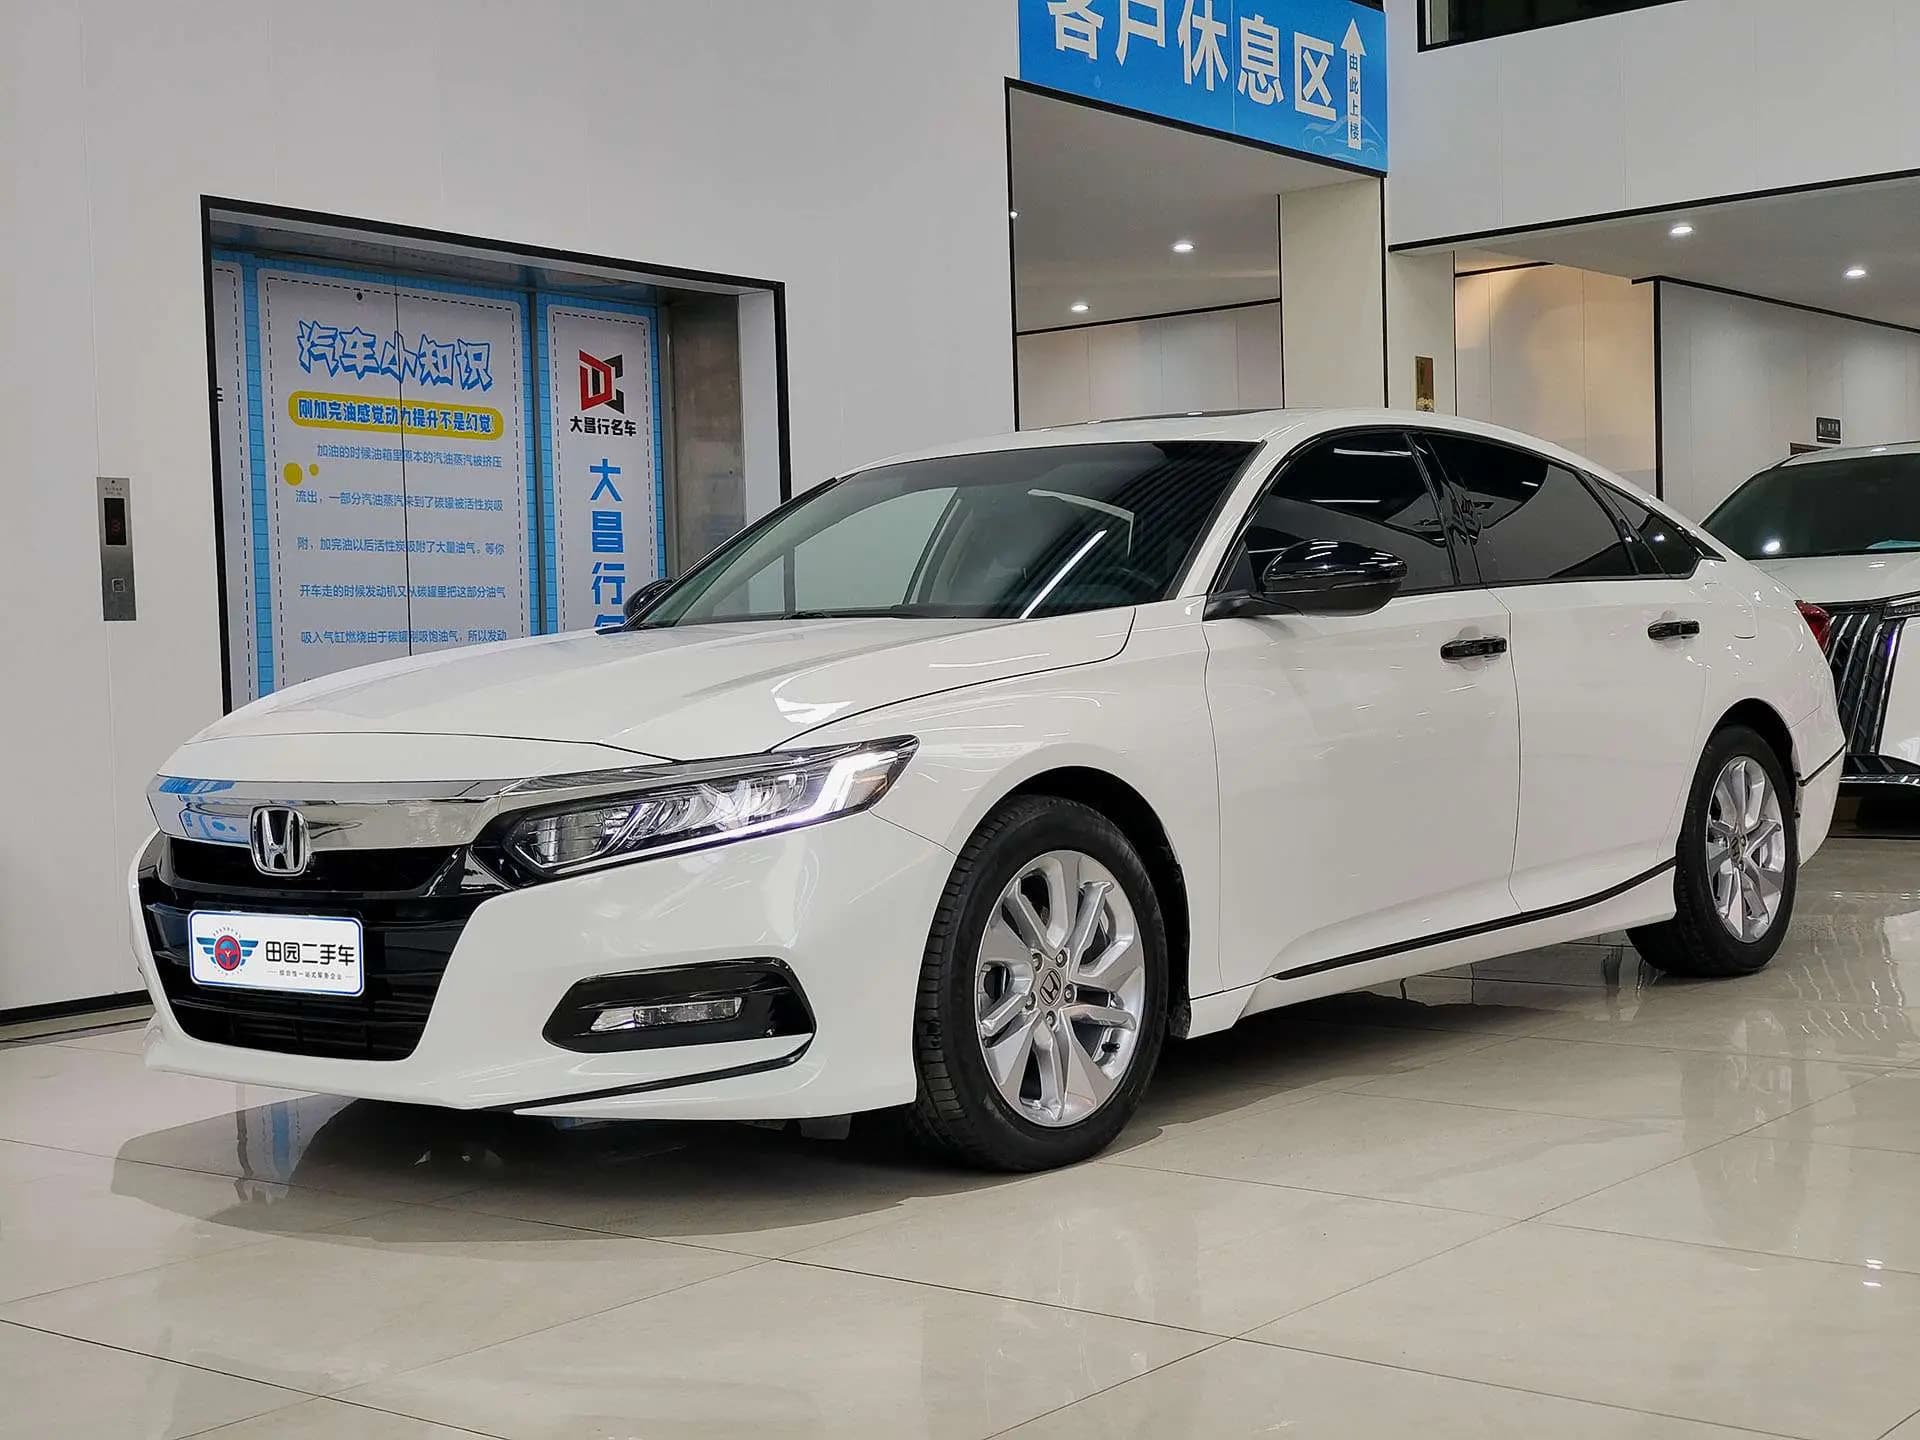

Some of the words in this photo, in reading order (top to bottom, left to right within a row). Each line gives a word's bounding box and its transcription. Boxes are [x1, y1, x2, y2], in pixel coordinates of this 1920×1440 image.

[297, 319, 493, 392] 汽车小知识
[570, 415, 637, 437] 大昌行名车
[265, 941, 355, 966] 田园二手车
